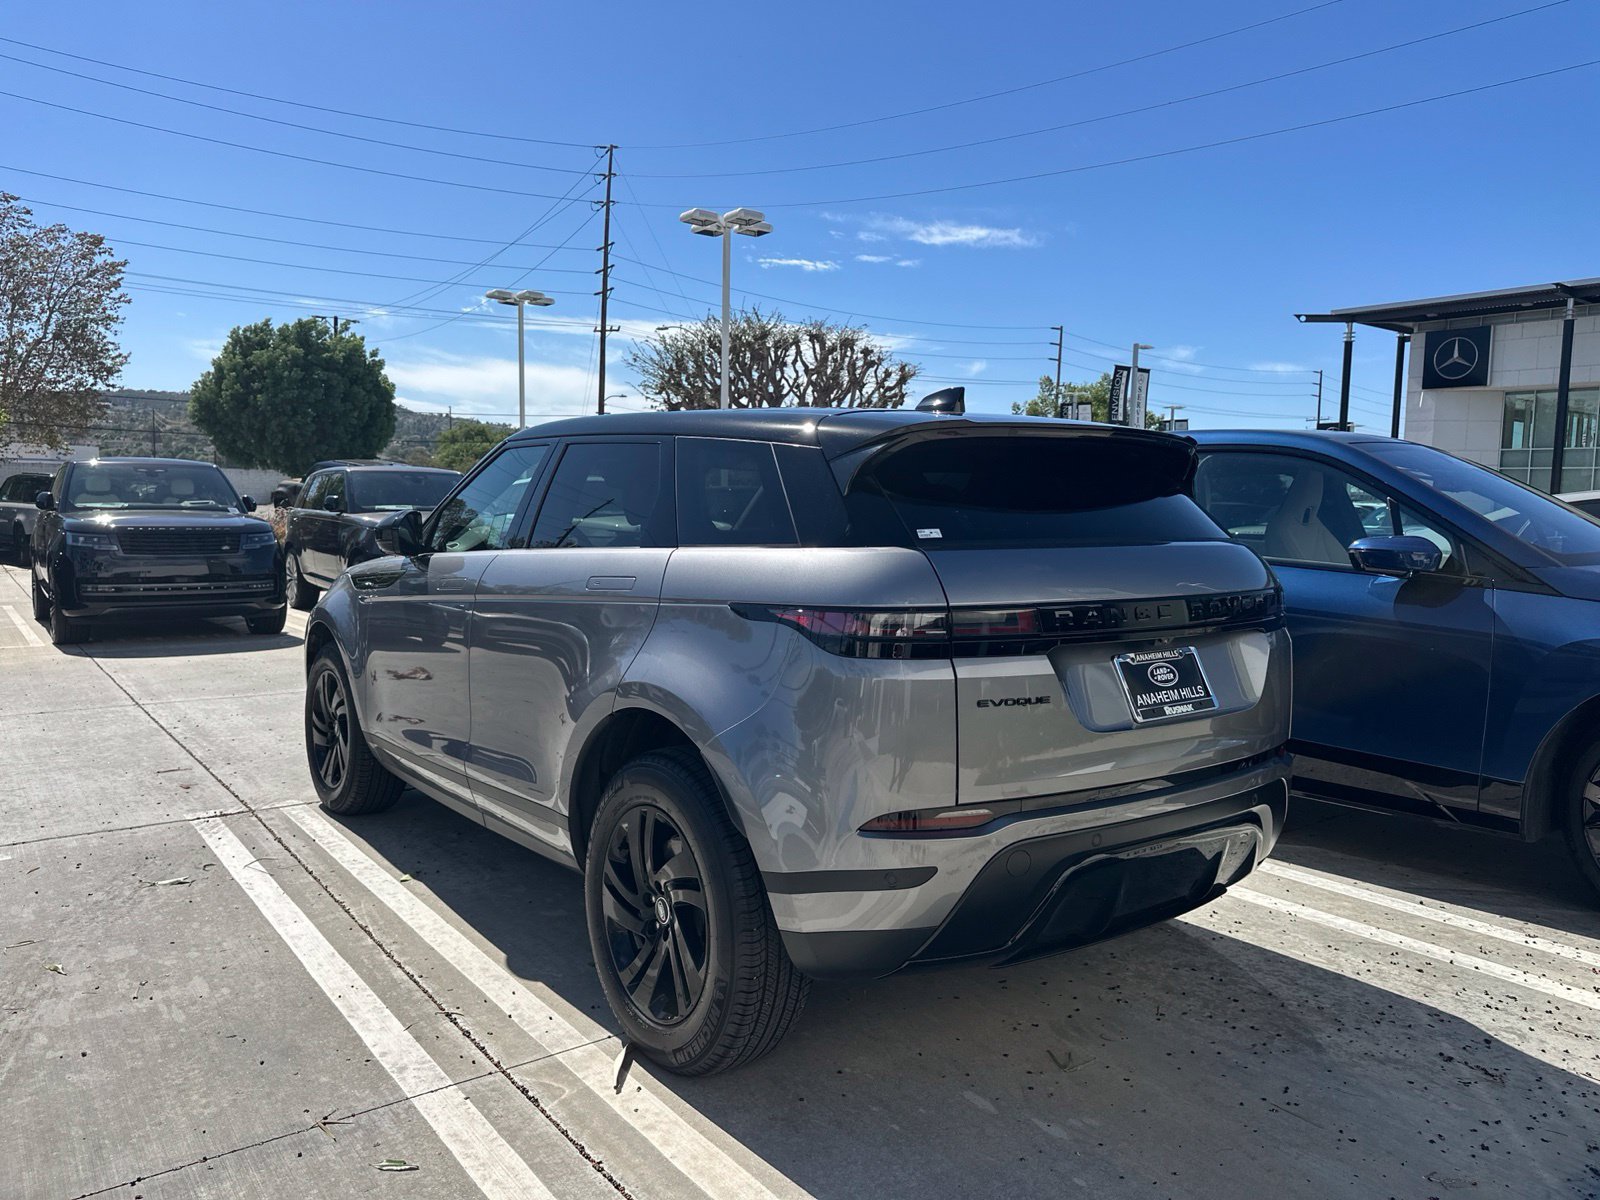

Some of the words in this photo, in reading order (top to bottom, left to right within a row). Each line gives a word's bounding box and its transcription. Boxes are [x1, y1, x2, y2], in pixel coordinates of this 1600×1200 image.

[1111, 369, 1123, 421] ENVISION
[1054, 604, 1172, 626] RANGE
[1136, 652, 1163, 662] ANAHEIM
[1163, 649, 1179, 658] HILLS
[1153, 667, 1167, 675] LAND
[1157, 673, 1174, 682] ROVER
[976, 695, 1051, 708] EVOQUE
[1137, 689, 1180, 707] ANAHEIM
[1180, 685, 1205, 699] HILLS
[1163, 703, 1195, 715] RUSNAK
[675, 1002, 721, 1063] MICHELIN
